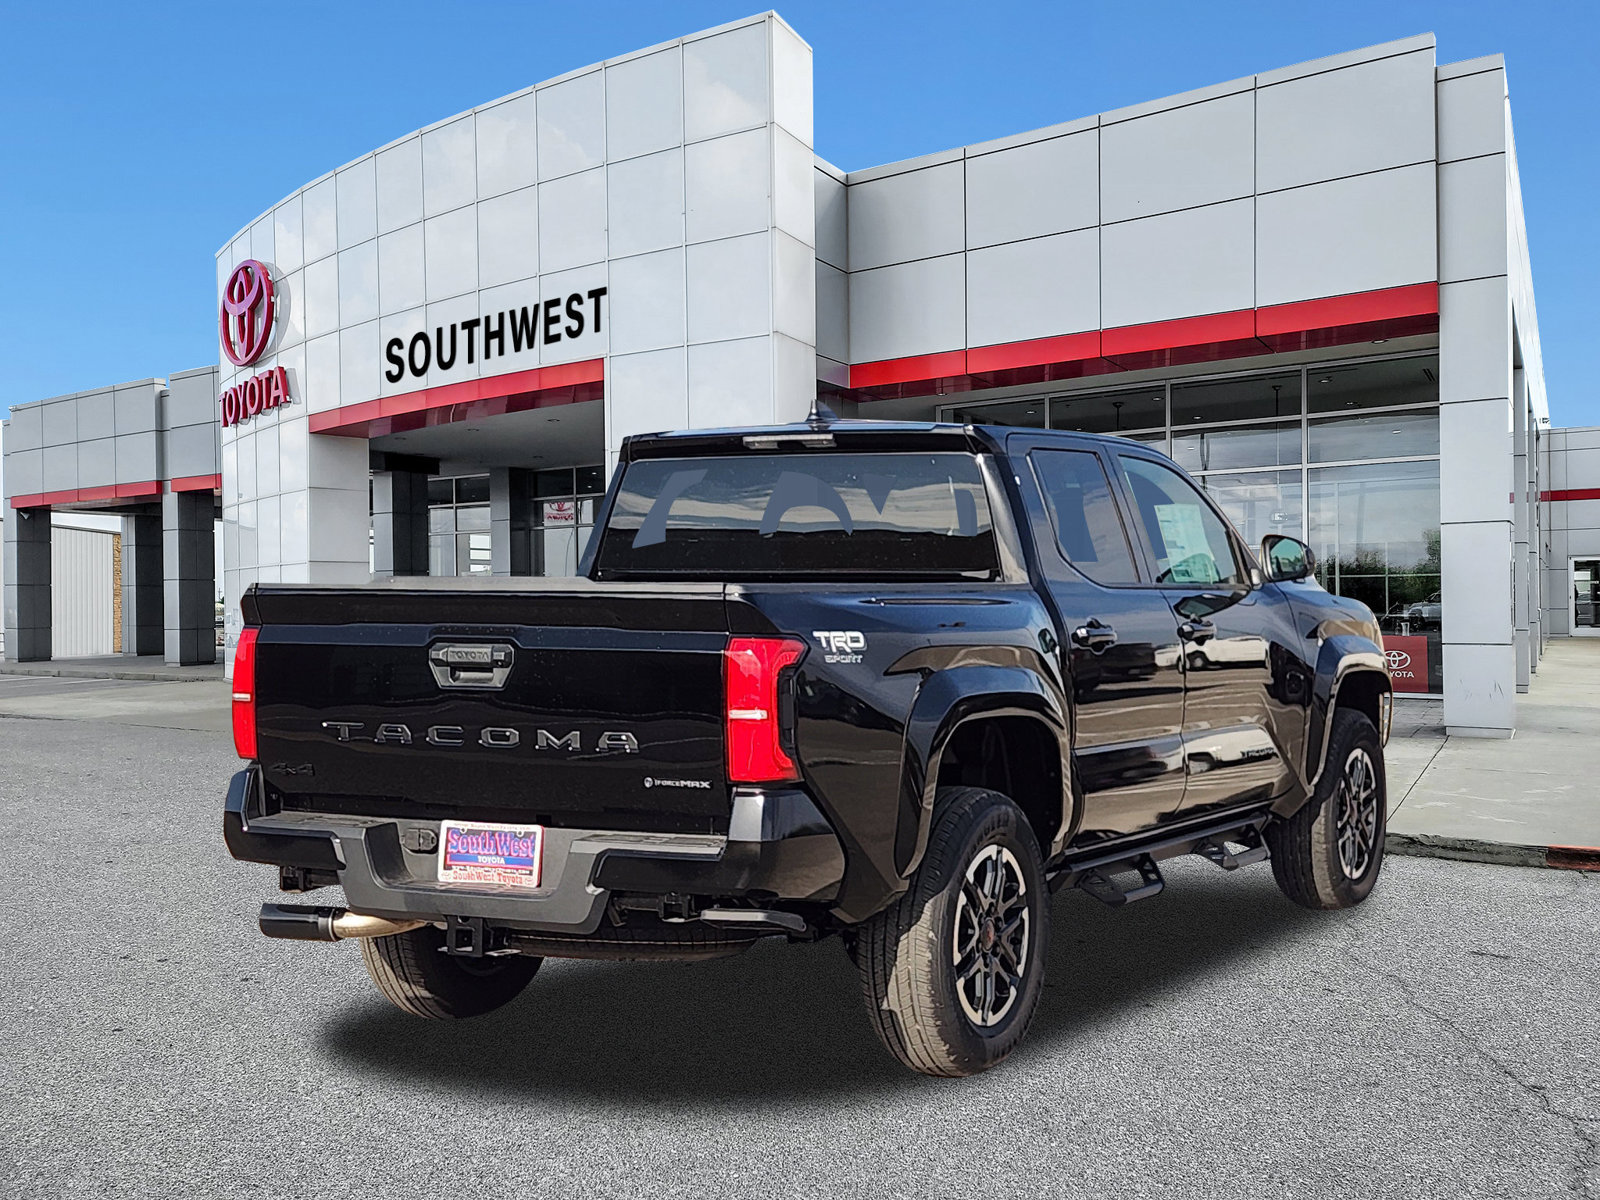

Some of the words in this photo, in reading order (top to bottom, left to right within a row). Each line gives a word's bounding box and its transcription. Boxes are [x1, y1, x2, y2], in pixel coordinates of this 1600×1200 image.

[385, 287, 607, 383] SOUTHWEST
[218, 366, 290, 428] TOYOTA
[813, 631, 866, 652] TRD
[450, 650, 489, 661] TOYOTA
[825, 654, 863, 663] SPORT
[321, 721, 640, 753] TACOMA
[477, 855, 505, 864] TOYOTA
[497, 872, 523, 887] Toyota
